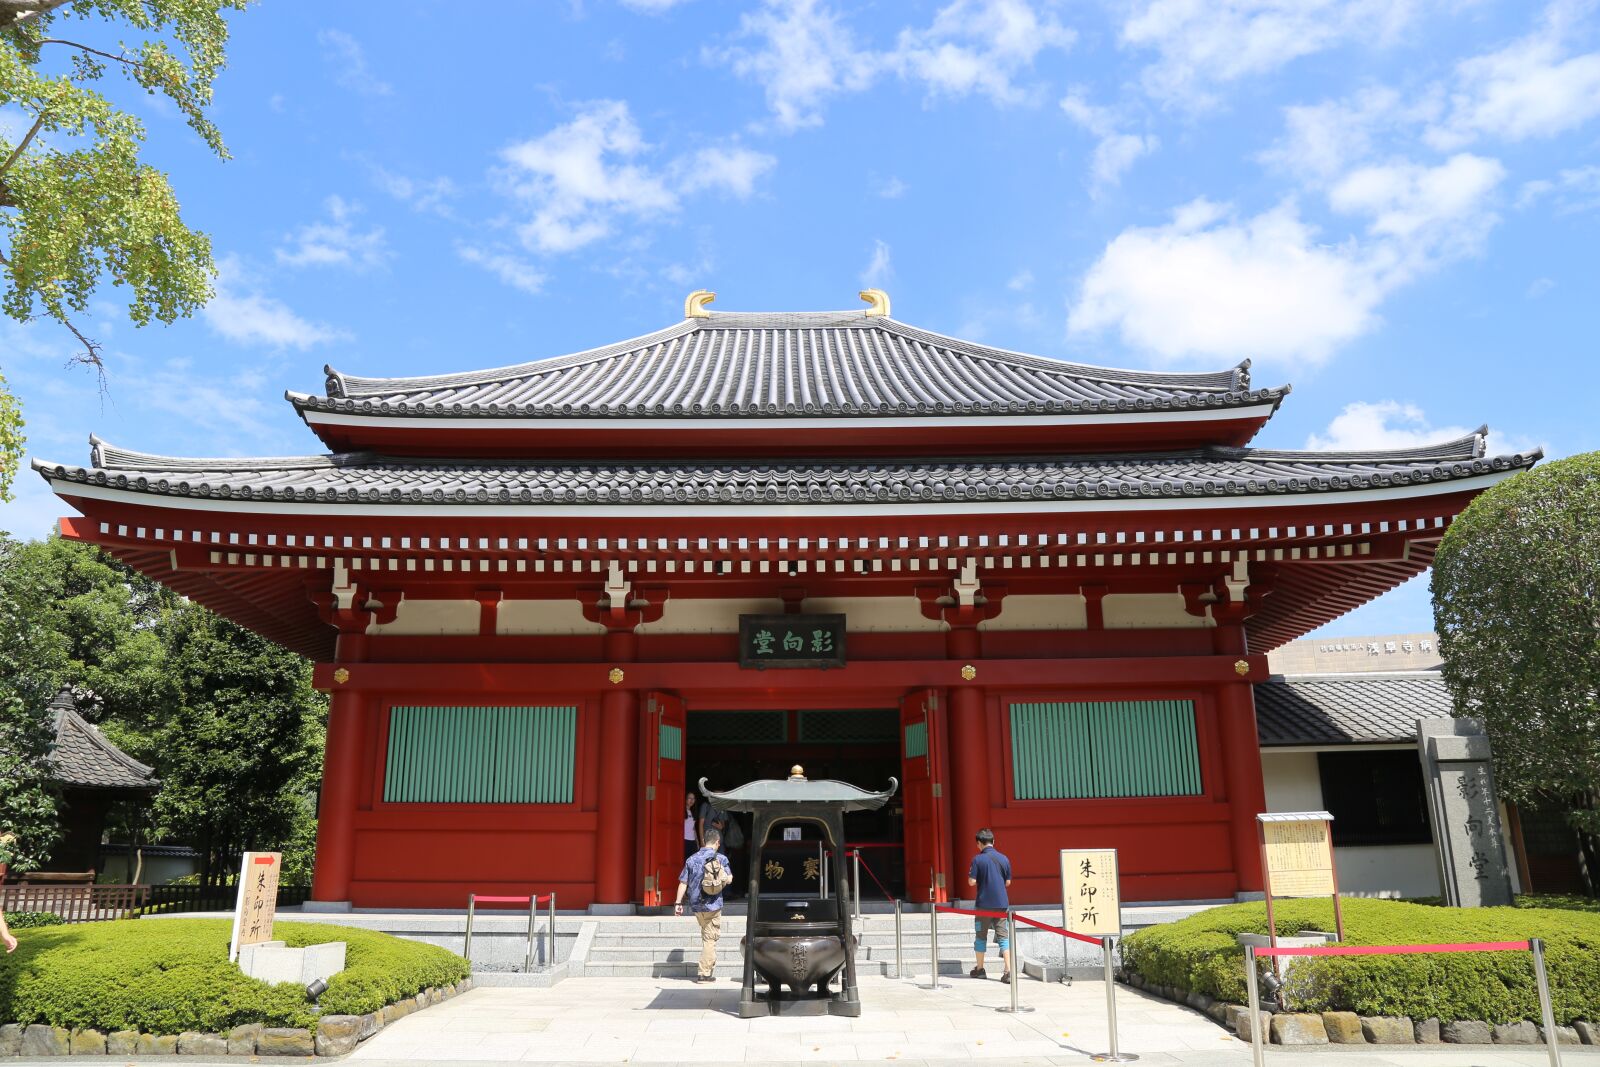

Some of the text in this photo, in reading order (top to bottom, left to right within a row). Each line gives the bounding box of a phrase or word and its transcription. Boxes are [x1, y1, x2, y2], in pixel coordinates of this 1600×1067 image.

[752, 629, 833, 655] 影向堂
[1456, 775, 1490, 880] 影向堂
[249, 870, 266, 940] 朱印所
[1080, 858, 1099, 927] 朱印所
